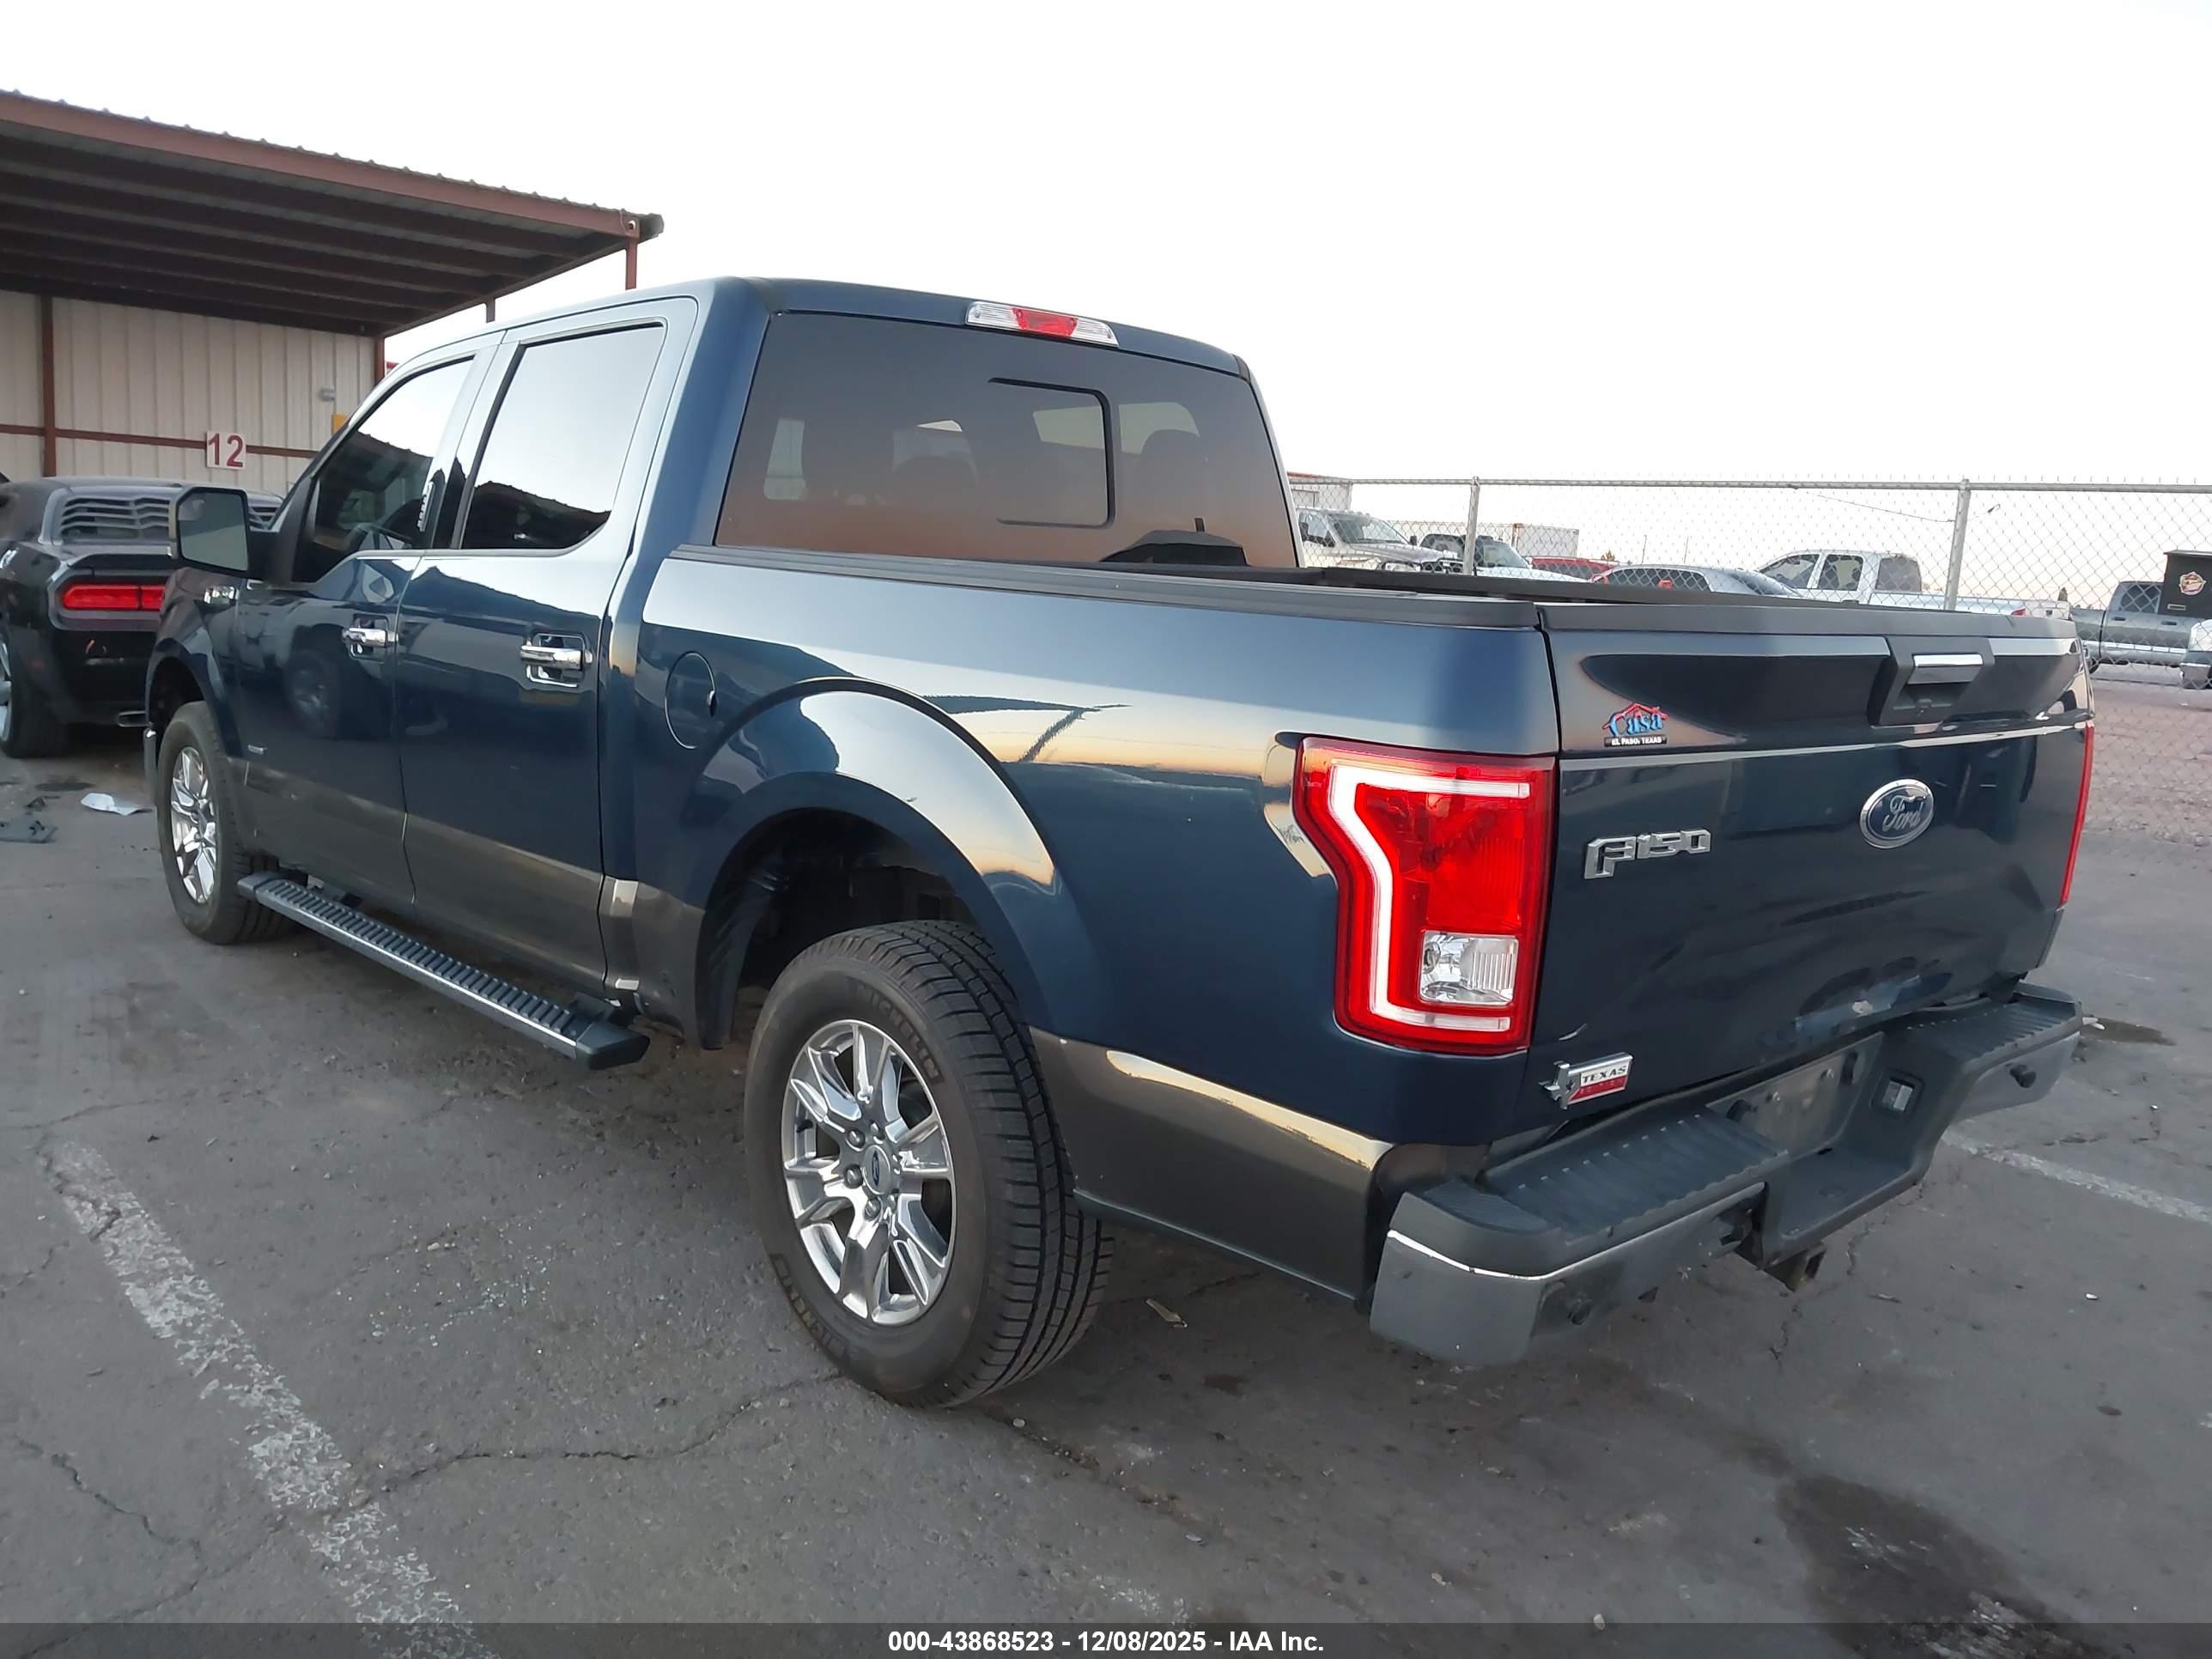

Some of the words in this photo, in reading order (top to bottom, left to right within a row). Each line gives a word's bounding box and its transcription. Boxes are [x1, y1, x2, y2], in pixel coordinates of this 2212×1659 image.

[208, 433, 244, 468] 12
[1609, 711, 1664, 737] Casa
[1611, 738, 1620, 746] EL
[1641, 736, 1662, 744] TEXAS
[1881, 794, 1924, 832] Ford
[1582, 1066, 1627, 1084] TEXAS
